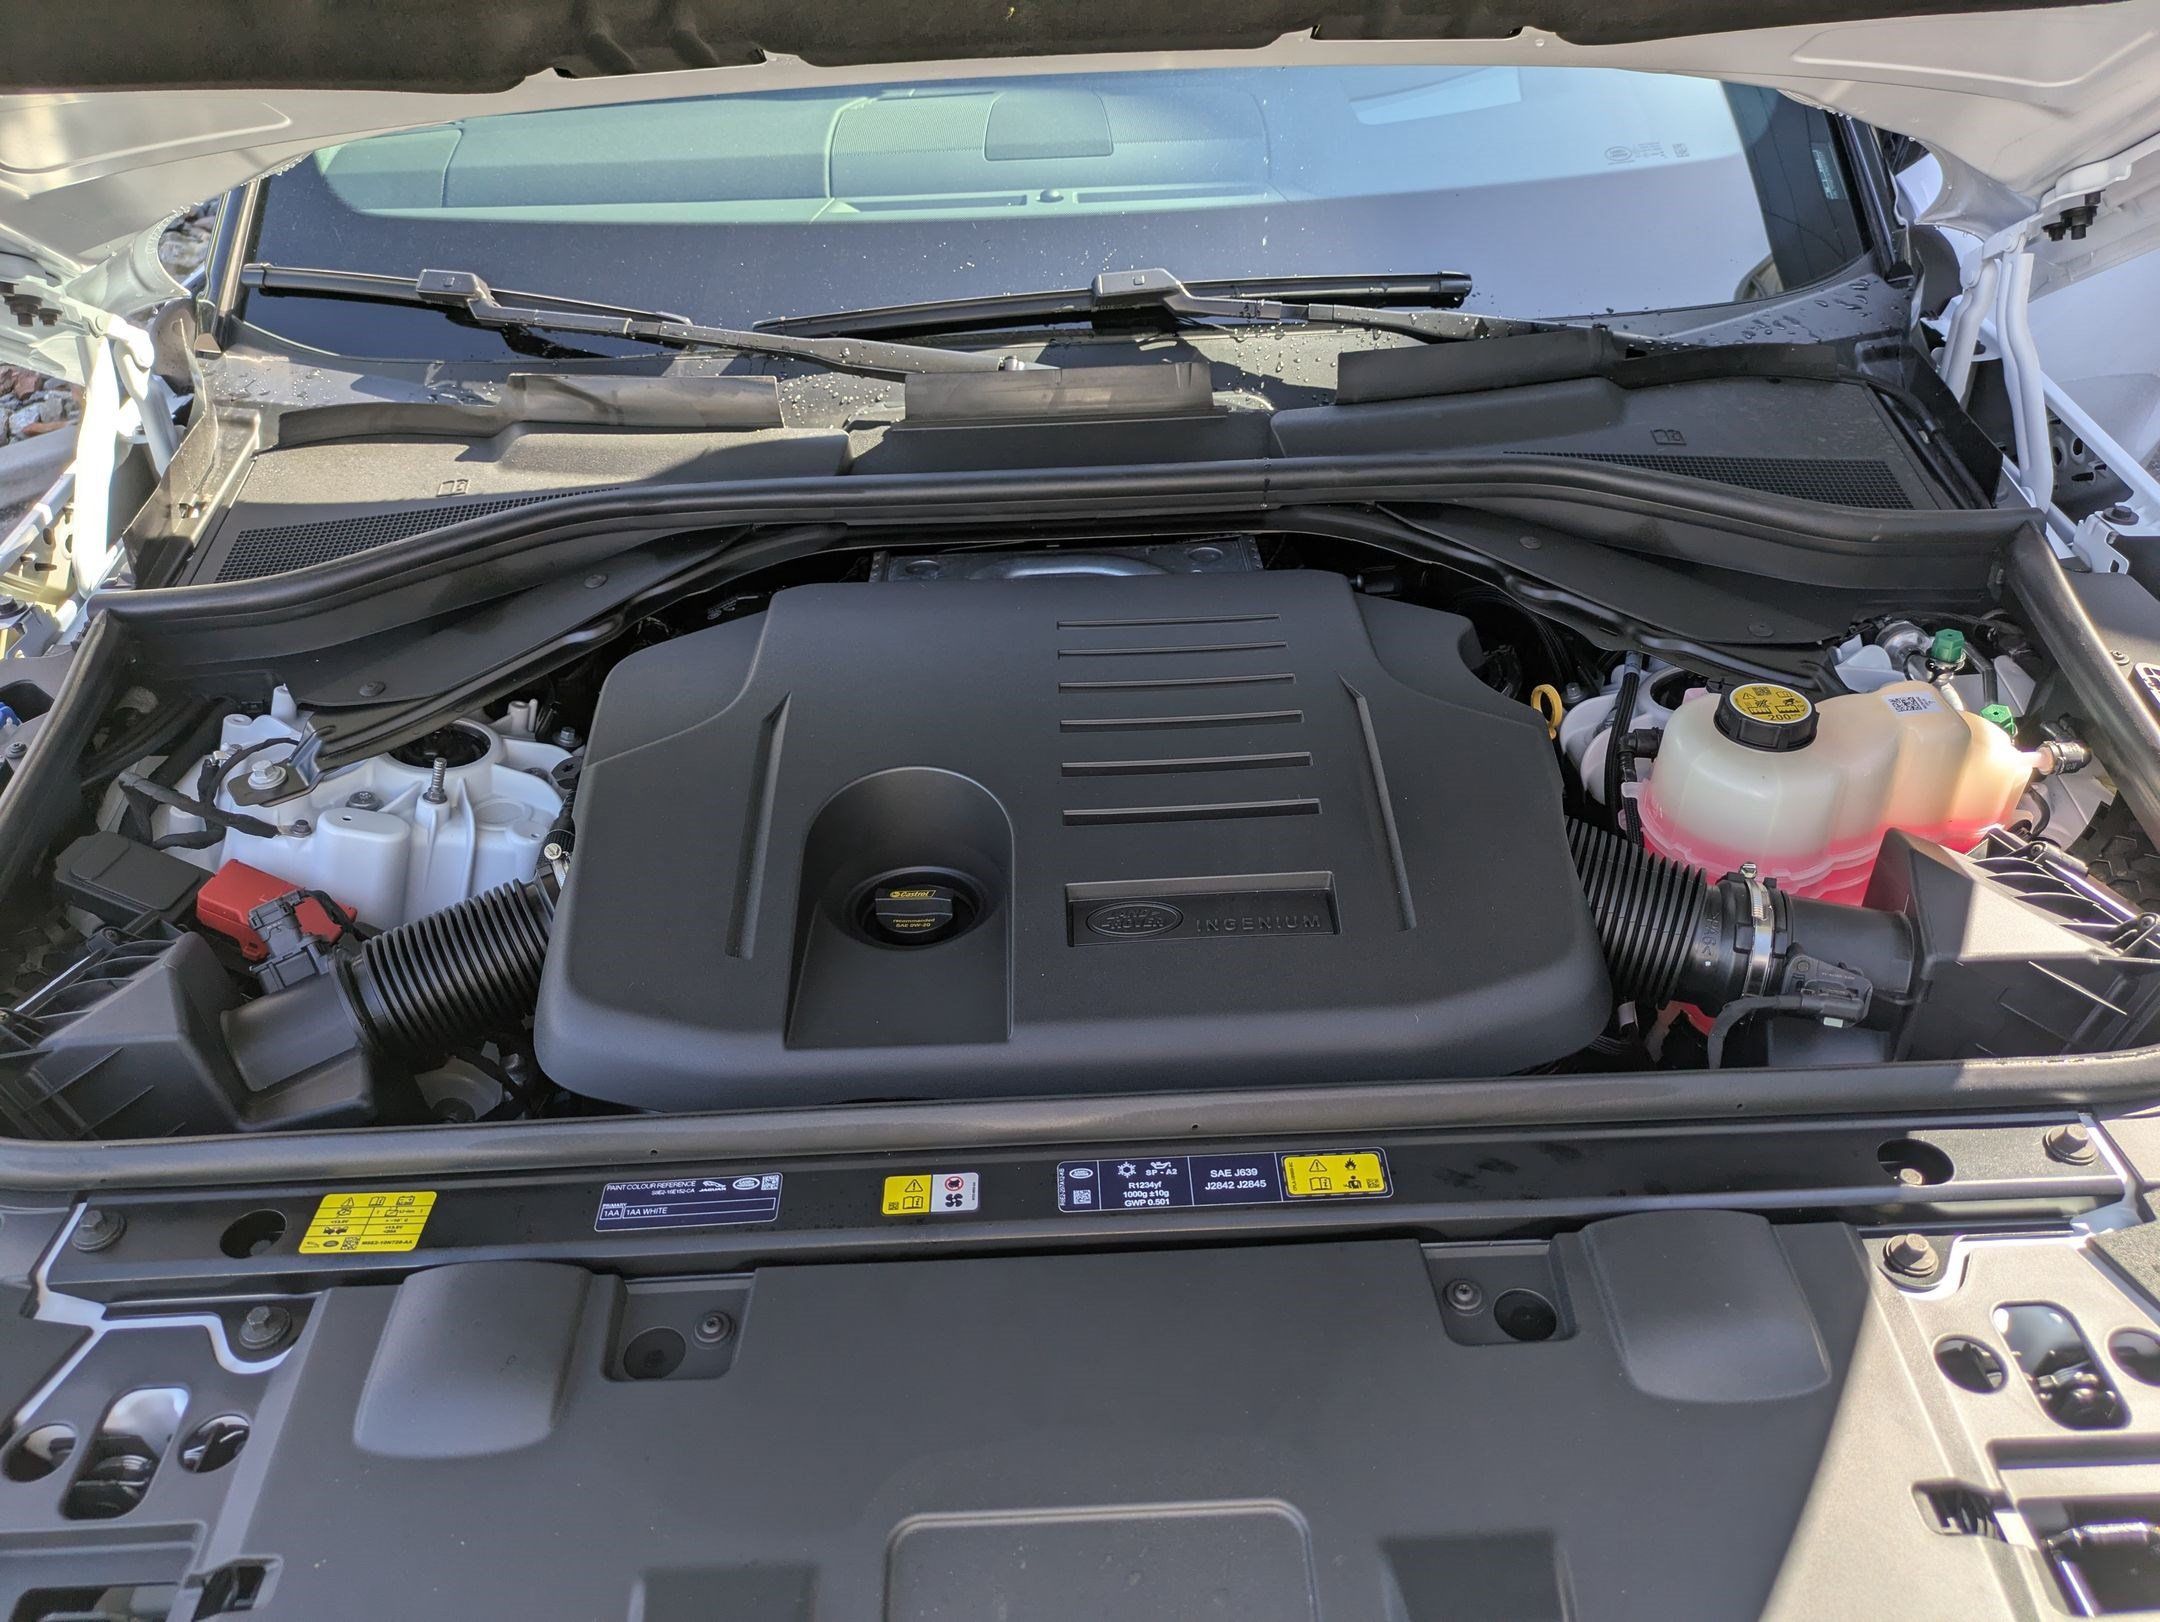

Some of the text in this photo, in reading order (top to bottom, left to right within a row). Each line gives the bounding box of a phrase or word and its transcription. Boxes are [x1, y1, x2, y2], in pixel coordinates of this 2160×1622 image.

[901, 890, 929, 898] Castrol
[1196, 915, 1322, 933] INGENIUM
[1210, 1168, 1258, 1178] SAE J639
[626, 1182, 657, 1190] COLOUR
[656, 1181, 696, 1189] REFERENCE
[1128, 1181, 1162, 1189] R1234yf
[1205, 1179, 1267, 1190] J2842 J2845
[1122, 1190, 1148, 1198] 1000g
[1124, 1198, 1170, 1207] GWP 0.501
[603, 1209, 620, 1217] 1AA
[626, 1206, 668, 1216] 1AA WHITE
